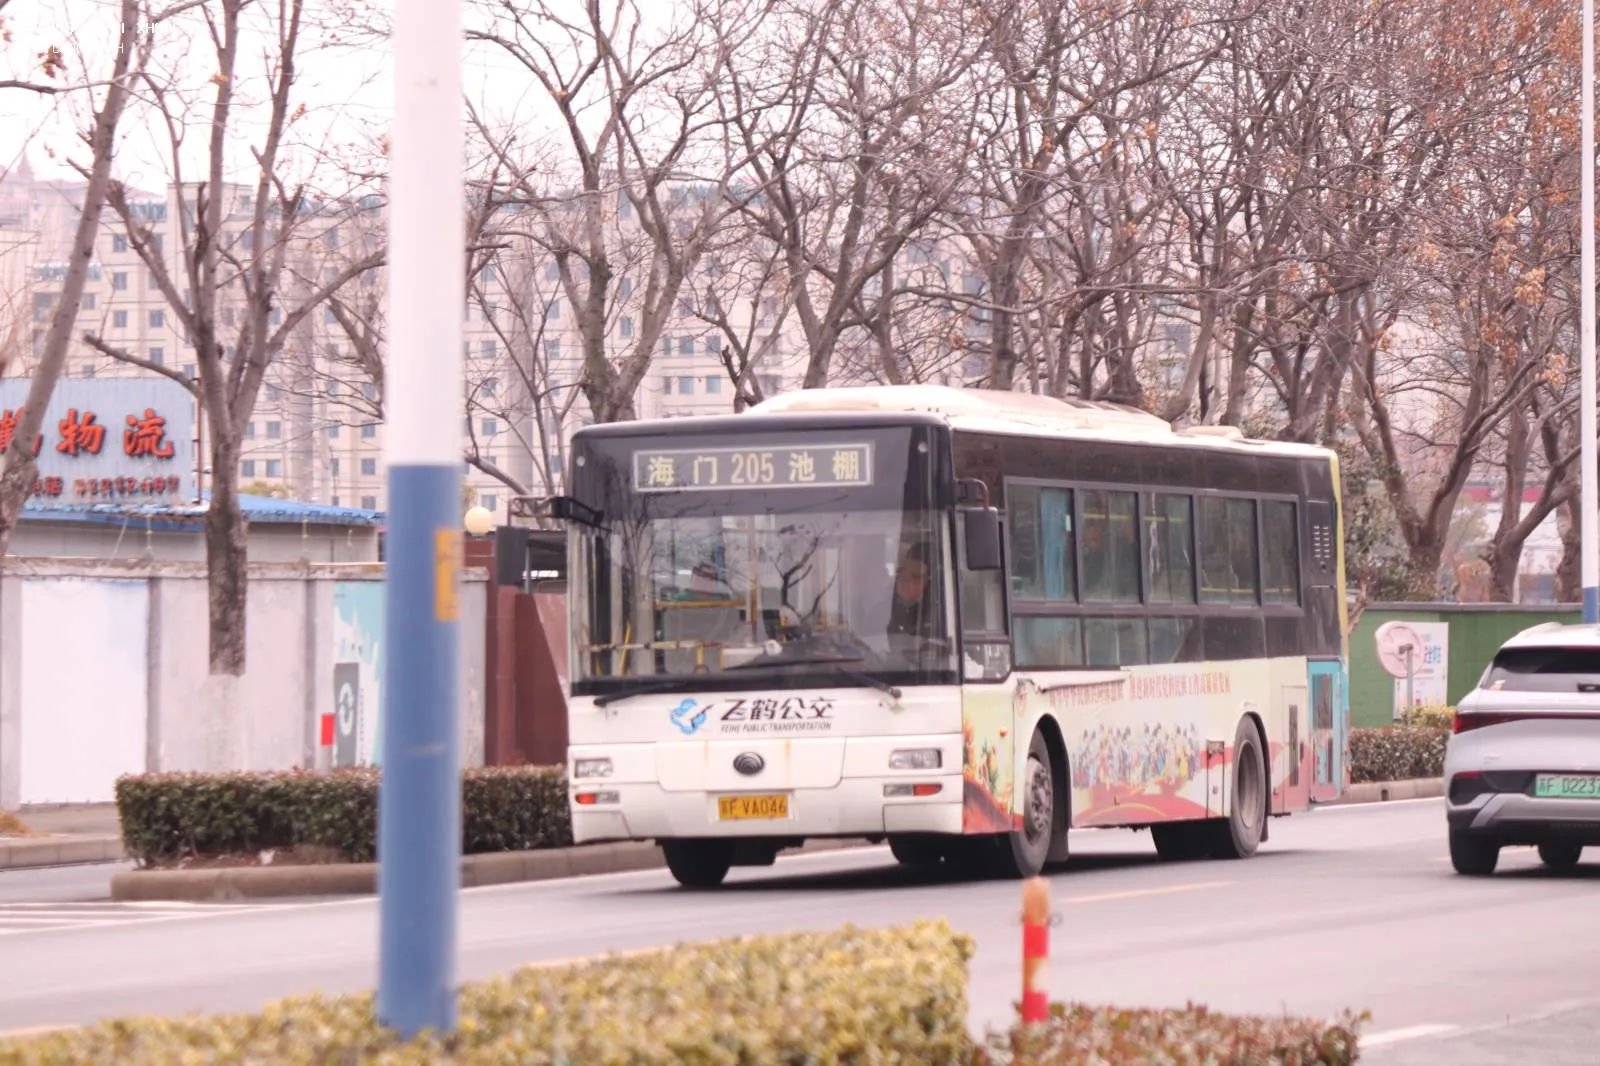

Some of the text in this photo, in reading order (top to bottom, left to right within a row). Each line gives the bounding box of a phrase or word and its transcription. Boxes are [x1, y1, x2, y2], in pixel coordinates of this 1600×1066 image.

[730, 452, 775, 484] 205
[720, 697, 836, 721] 飞鹤公交
[743, 723, 767, 733] PUBLIC
[769, 721, 832, 732] TRANSPORTATION
